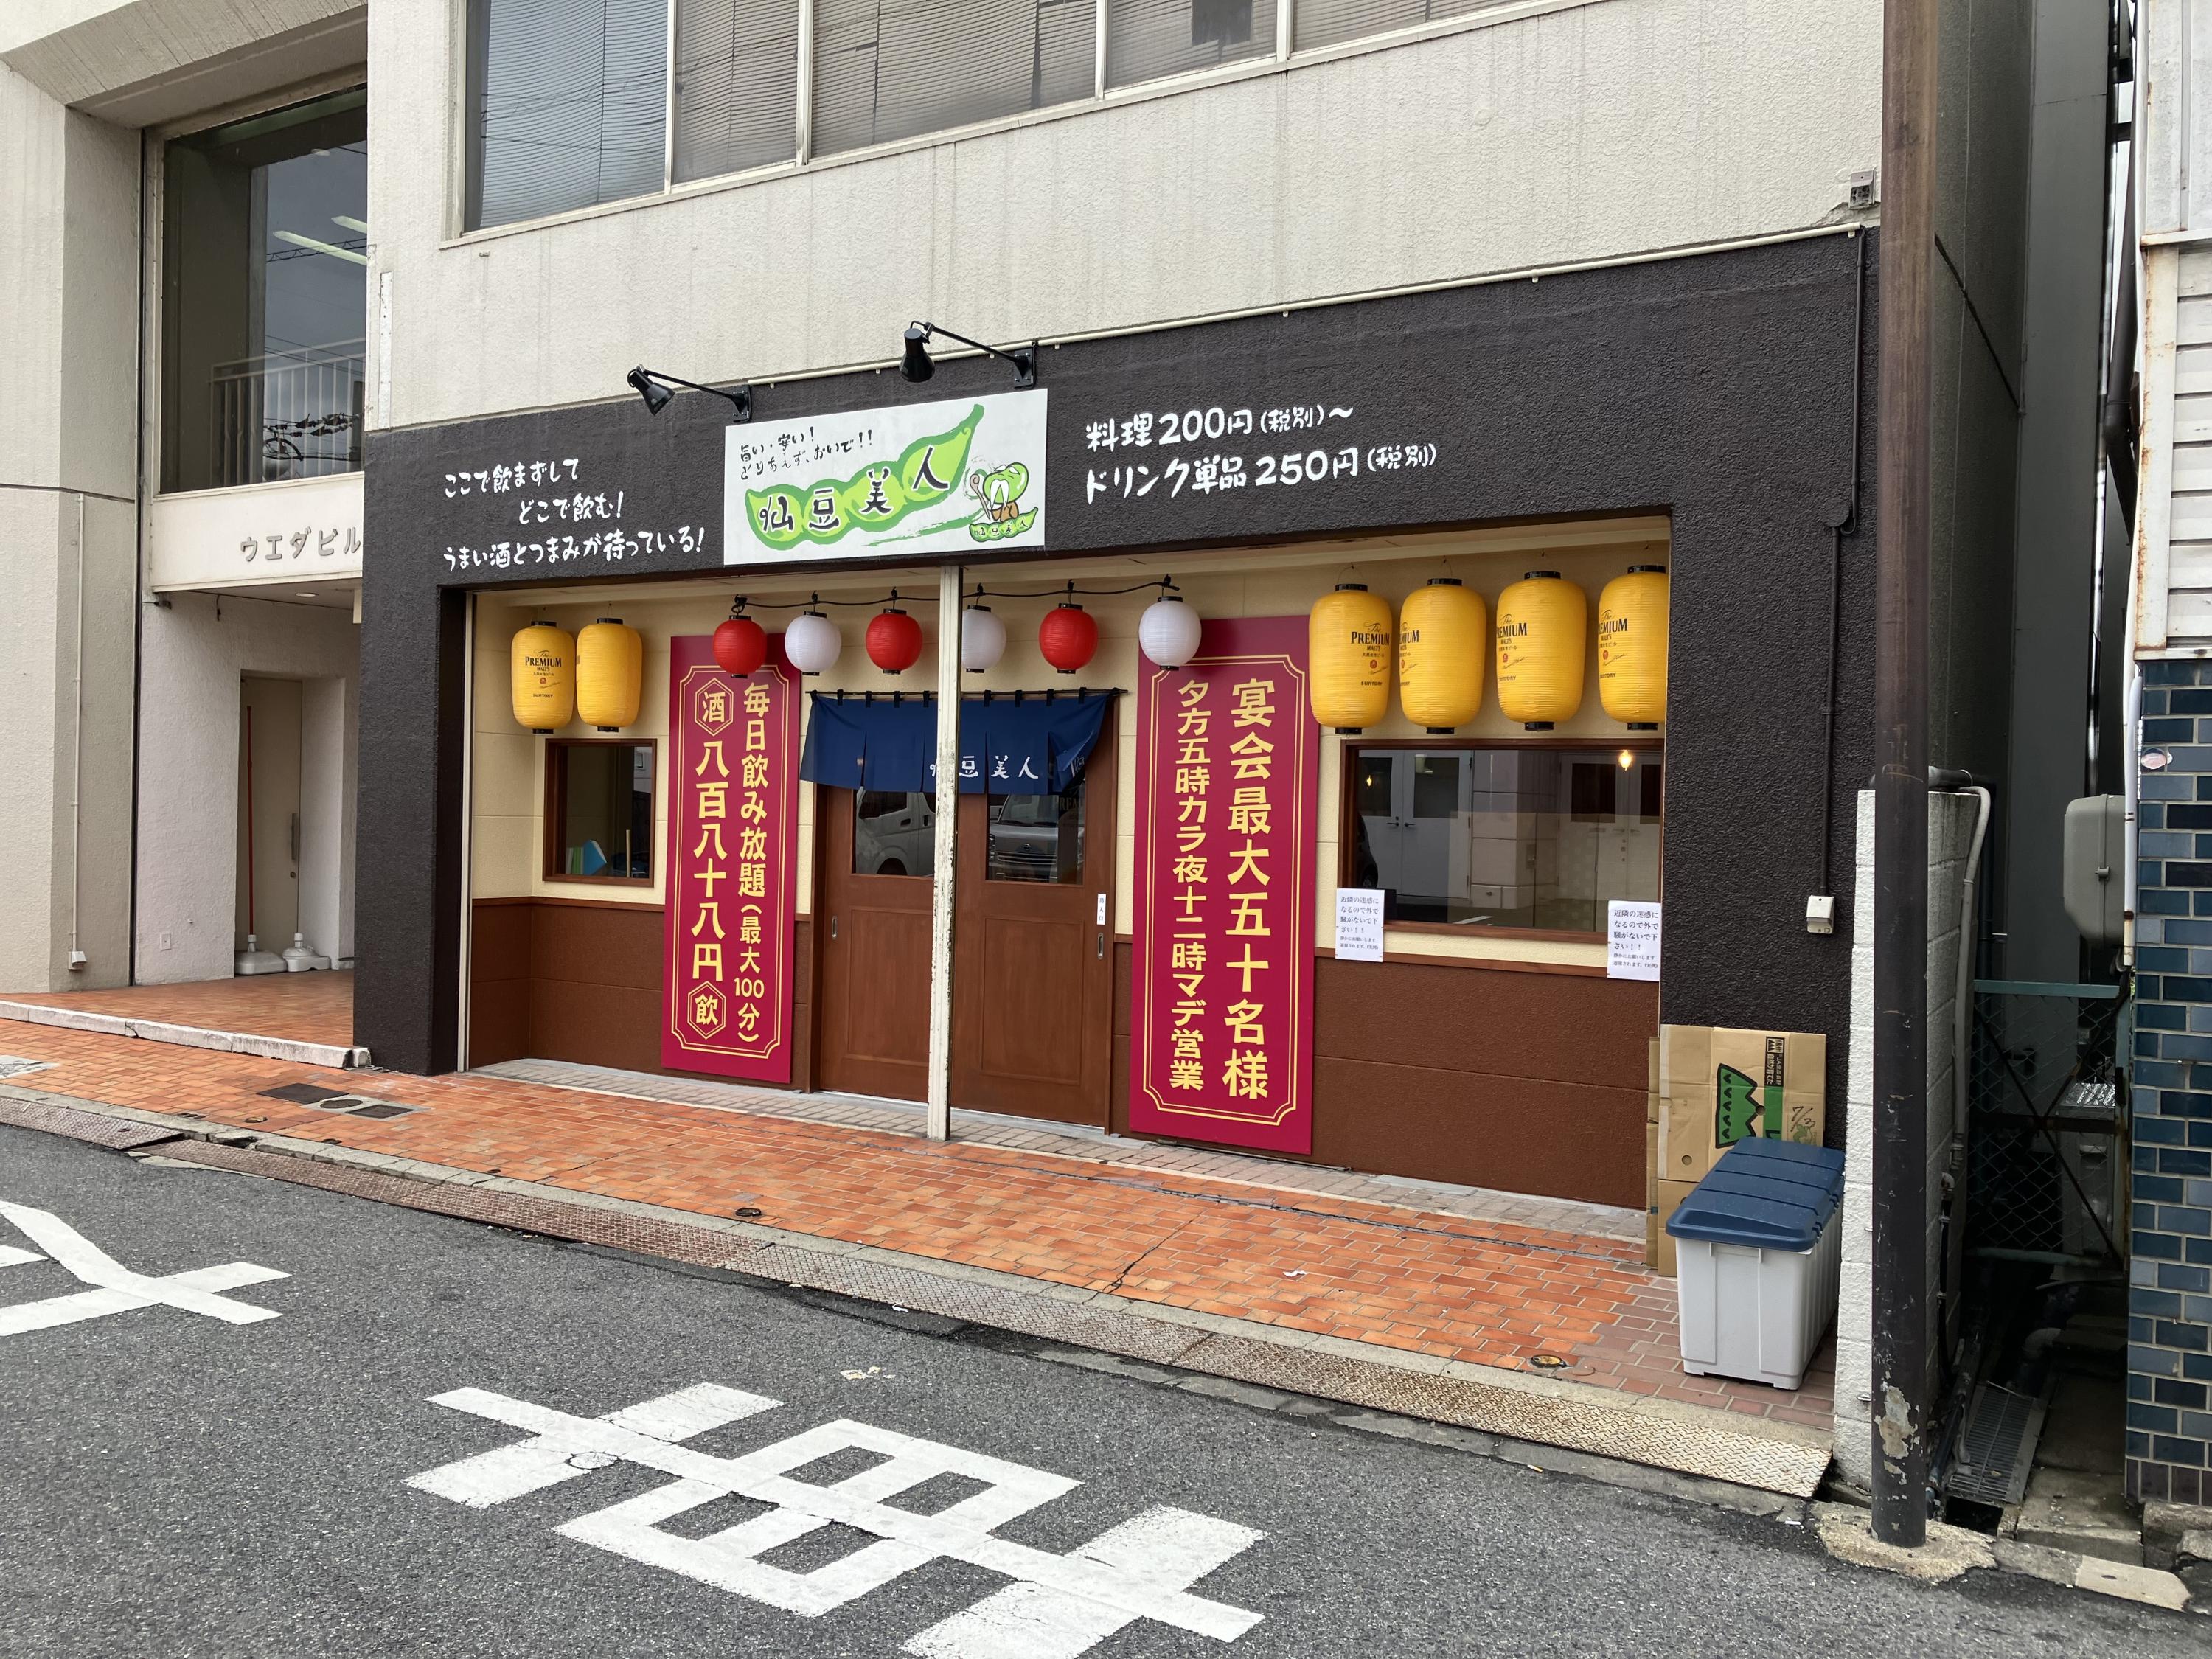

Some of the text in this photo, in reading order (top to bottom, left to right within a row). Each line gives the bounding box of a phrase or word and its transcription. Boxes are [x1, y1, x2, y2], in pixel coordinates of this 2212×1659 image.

[445, 458, 580, 498] ここで飲まずして
[758, 447, 948, 532] 仙豆美人
[518, 491, 624, 525] どこで飲む!
[240, 526, 361, 562] ウエダビル
[443, 526, 706, 571] うまい酒とつまみが待っている!
[1351, 631, 1390, 646] PREMIUM
[525, 656, 562, 667] PREMIUM
[702, 691, 726, 723] 酒
[1169, 679, 1212, 1091] 夕方五時カラ夜十二時マデ営業
[1222, 678, 1276, 1100] 宴会最大五十名様
[1340, 896, 1379, 904] 近隣の迷惑に
[1341, 906, 1380, 914] なるので外で
[1614, 909, 1659, 919] 近隣の迷惑に
[1340, 916, 1378, 925] 騒がないで下
[1614, 920, 1659, 930] なるので外で
[1613, 931, 1658, 941] 騒がないで下
[695, 993, 719, 1026] 飲
[1790, 1106, 1816, 1133] 7/3
